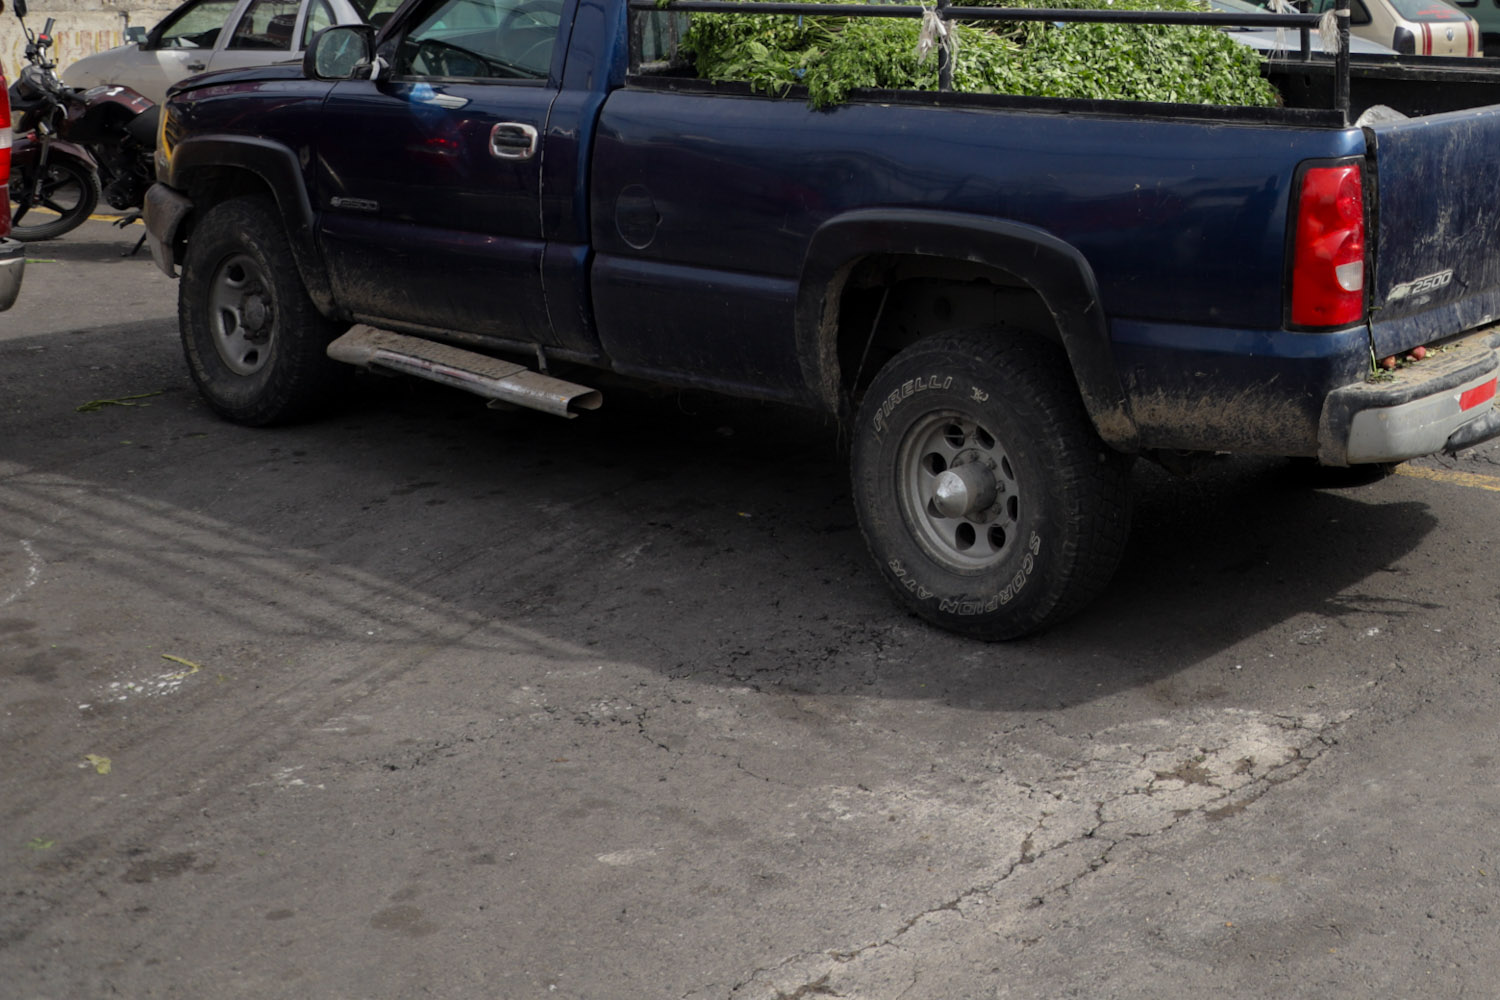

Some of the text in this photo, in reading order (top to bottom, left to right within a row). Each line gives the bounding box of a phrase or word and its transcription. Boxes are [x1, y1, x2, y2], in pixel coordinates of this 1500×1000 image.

[1412, 271, 1453, 294] 2500
[873, 374, 953, 433] PIRELLI
[938, 530, 1042, 616] SCORPION
